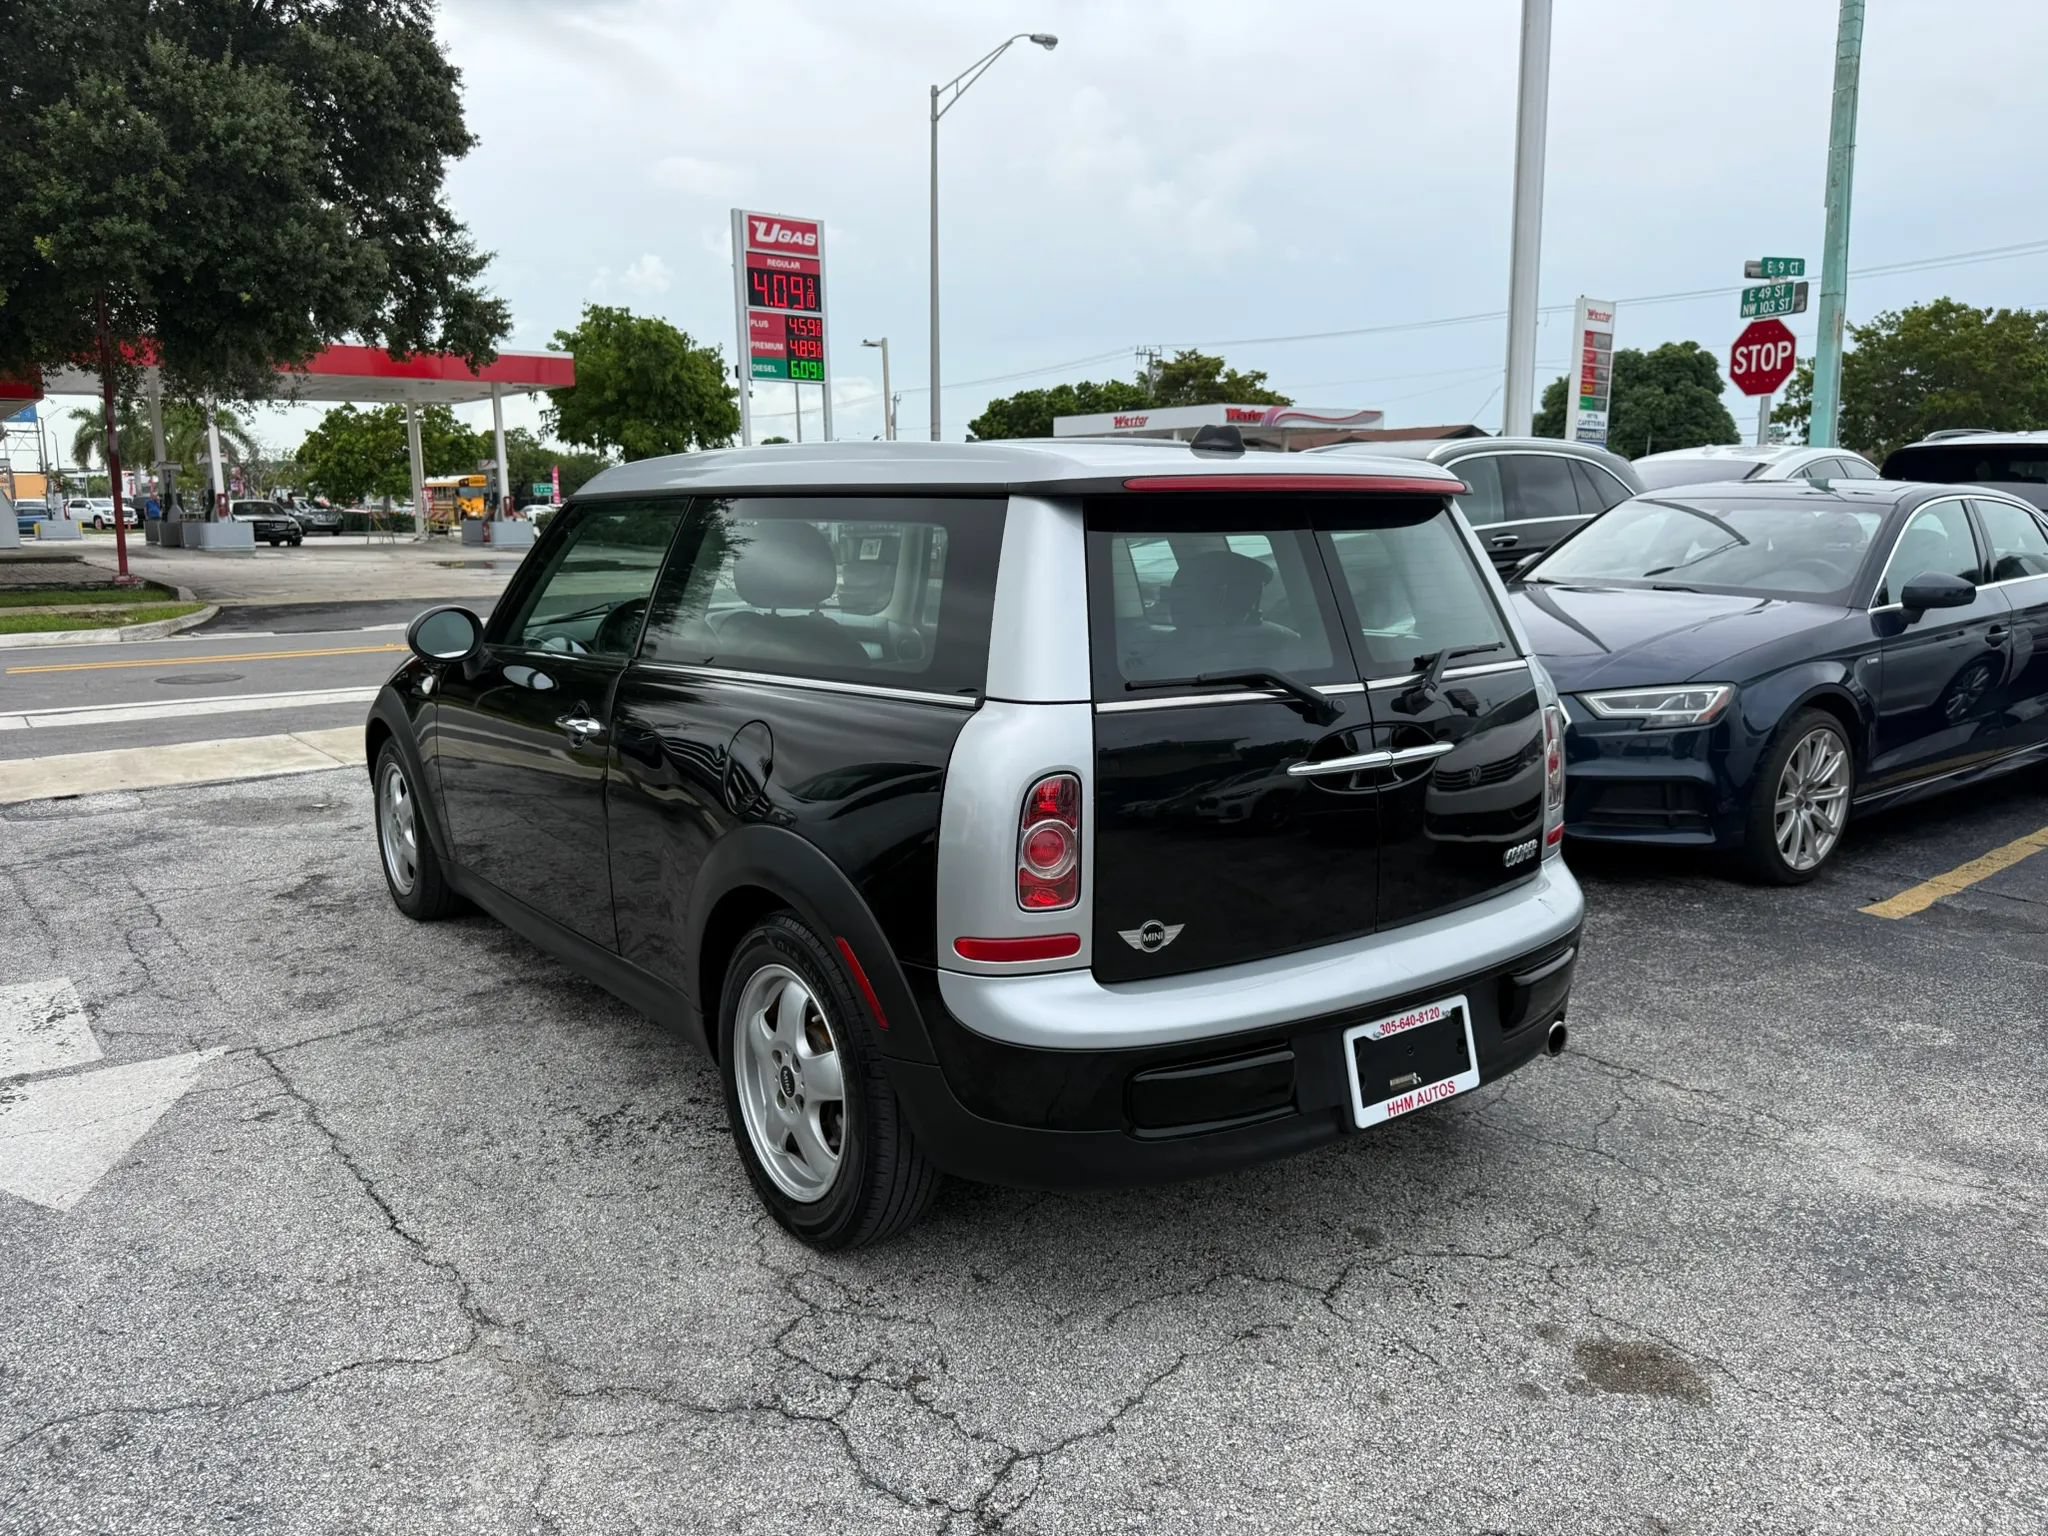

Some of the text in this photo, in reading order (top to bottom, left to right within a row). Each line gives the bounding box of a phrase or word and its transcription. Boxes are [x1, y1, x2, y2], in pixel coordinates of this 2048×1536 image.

[750, 220, 817, 247] UGAS
[766, 258, 801, 270] REGULAR
[1767, 261, 1800, 274] E 9 CT
[1749, 284, 1787, 302] E 49 ST
[1742, 297, 1791, 317] NW 103 ST
[750, 319, 769, 329] PLUS
[751, 341, 784, 351] PREMIUM
[1733, 340, 1792, 375] STOP
[752, 363, 777, 373] DIESEL
[1503, 839, 1538, 868] COOPER
[1143, 930, 1164, 942] MINI
[1379, 1006, 1441, 1036] 305-640-8120
[1386, 1080, 1456, 1117] HHM AUTOS
